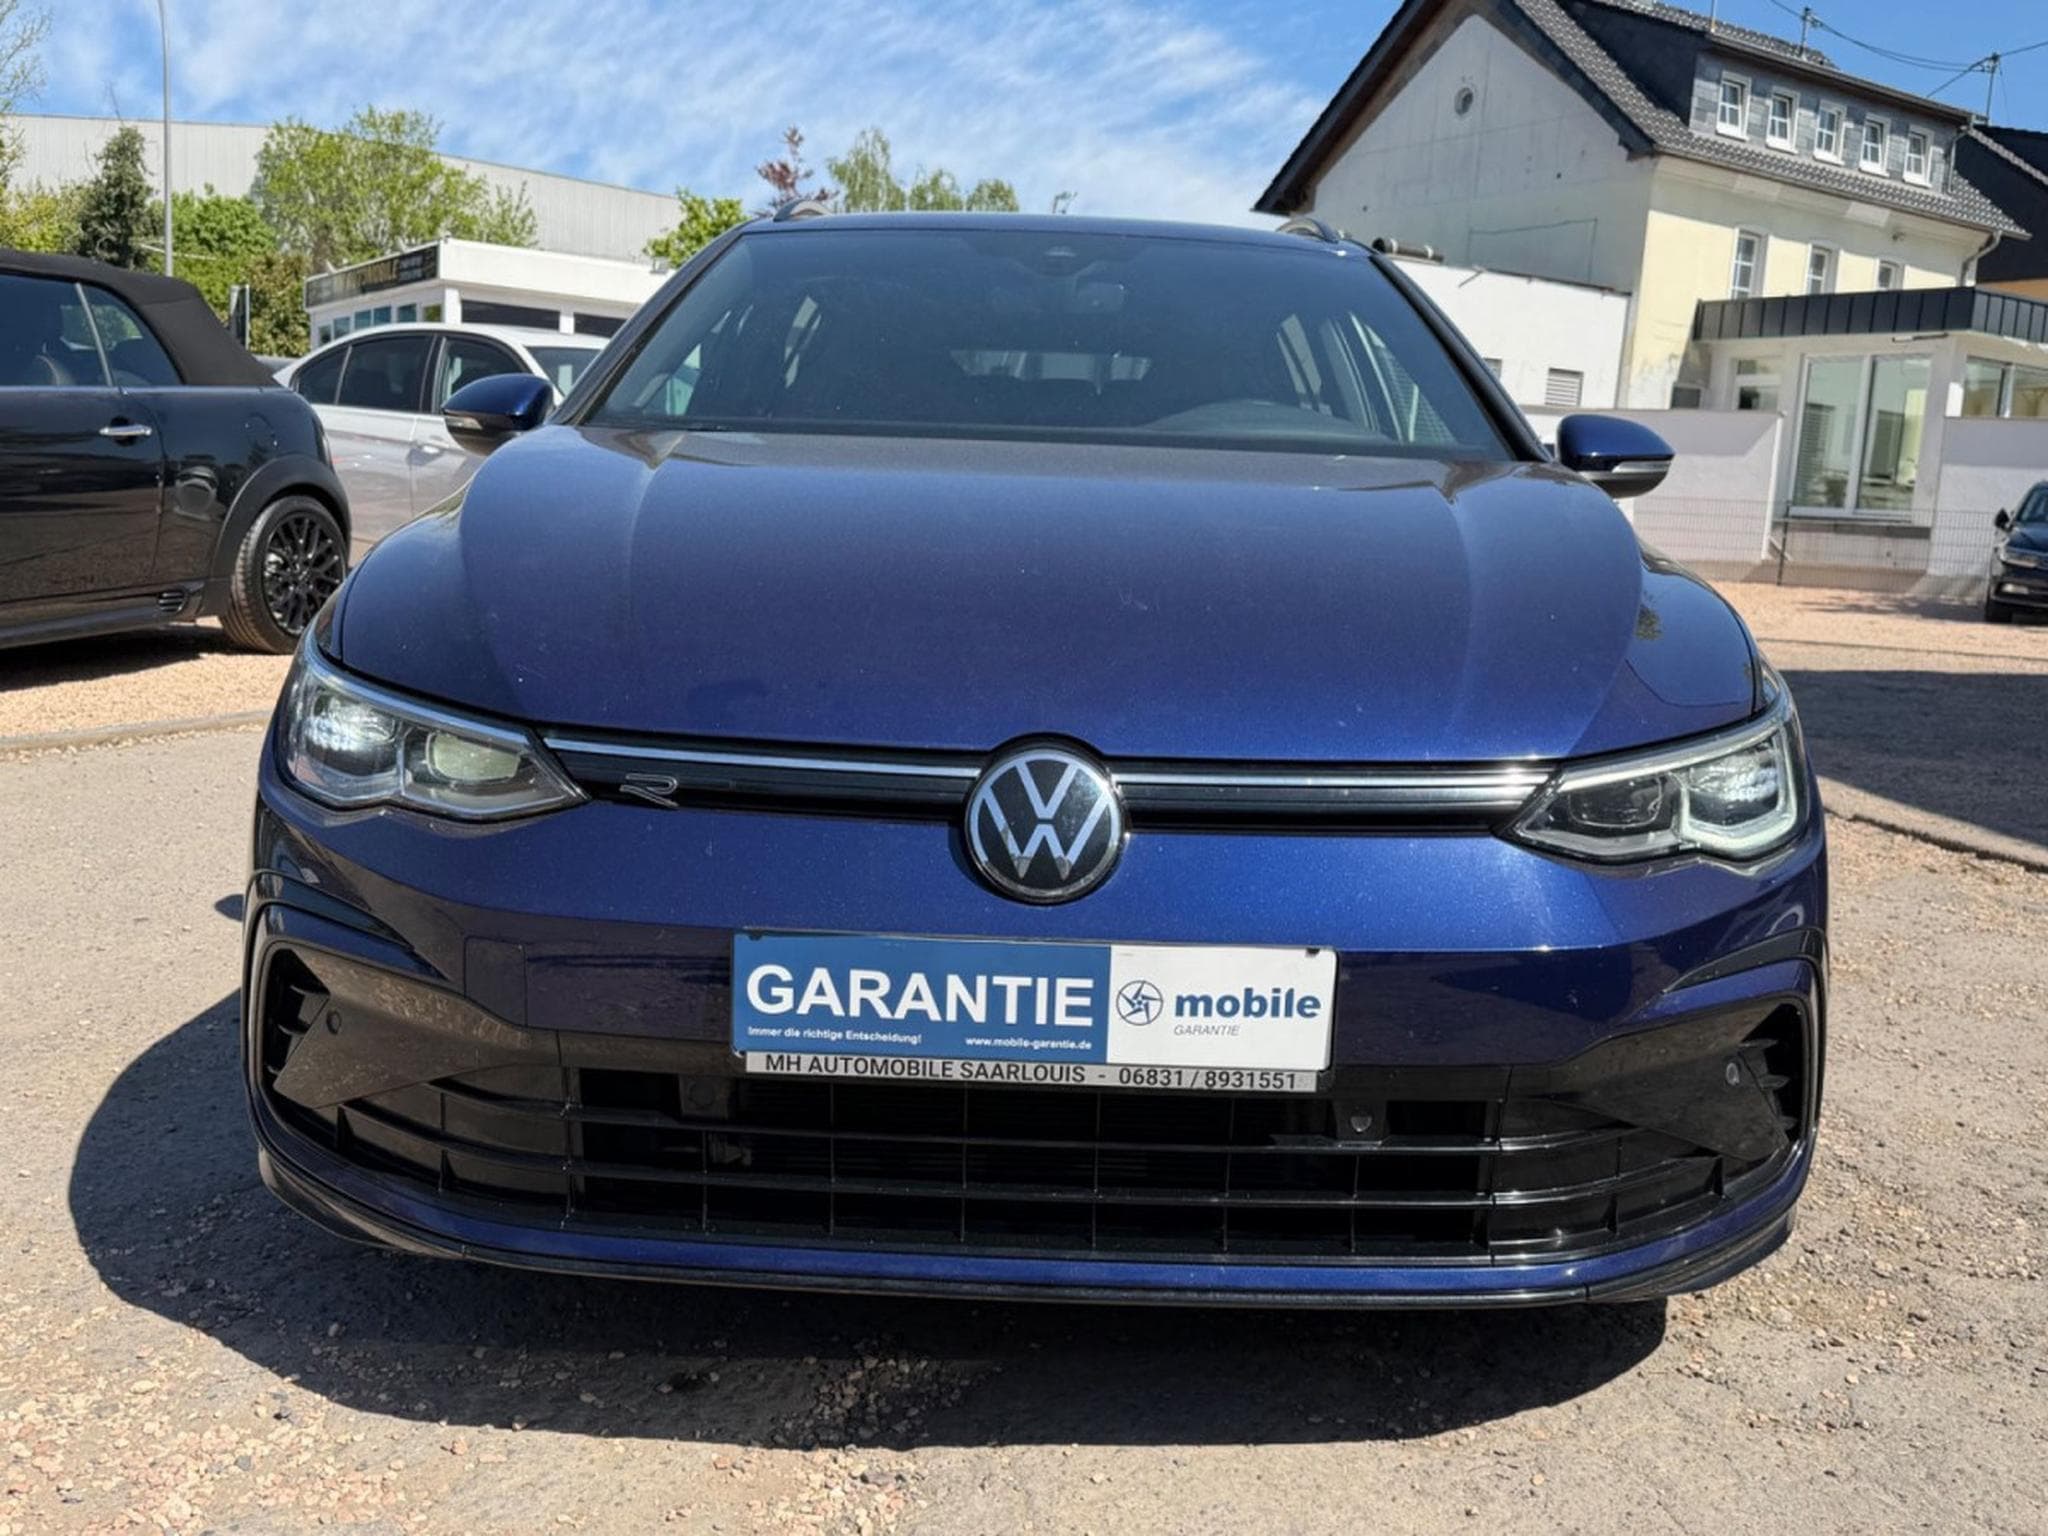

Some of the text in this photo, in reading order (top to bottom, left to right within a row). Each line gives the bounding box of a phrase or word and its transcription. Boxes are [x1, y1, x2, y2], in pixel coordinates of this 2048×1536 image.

[746, 964, 1094, 1027] GARANTIE
[1174, 987, 1322, 1019] mobile
[748, 1026, 922, 1045] Immer die richtige Entscheidung!
[1173, 1024, 1241, 1037] GARANTIE
[965, 1037, 1093, 1050] www.mobile-garantie.de
[765, 1054, 801, 1072] MH
[808, 1056, 954, 1078] AUTOMOBILE
[960, 1061, 1086, 1083] SAARLOUIS
